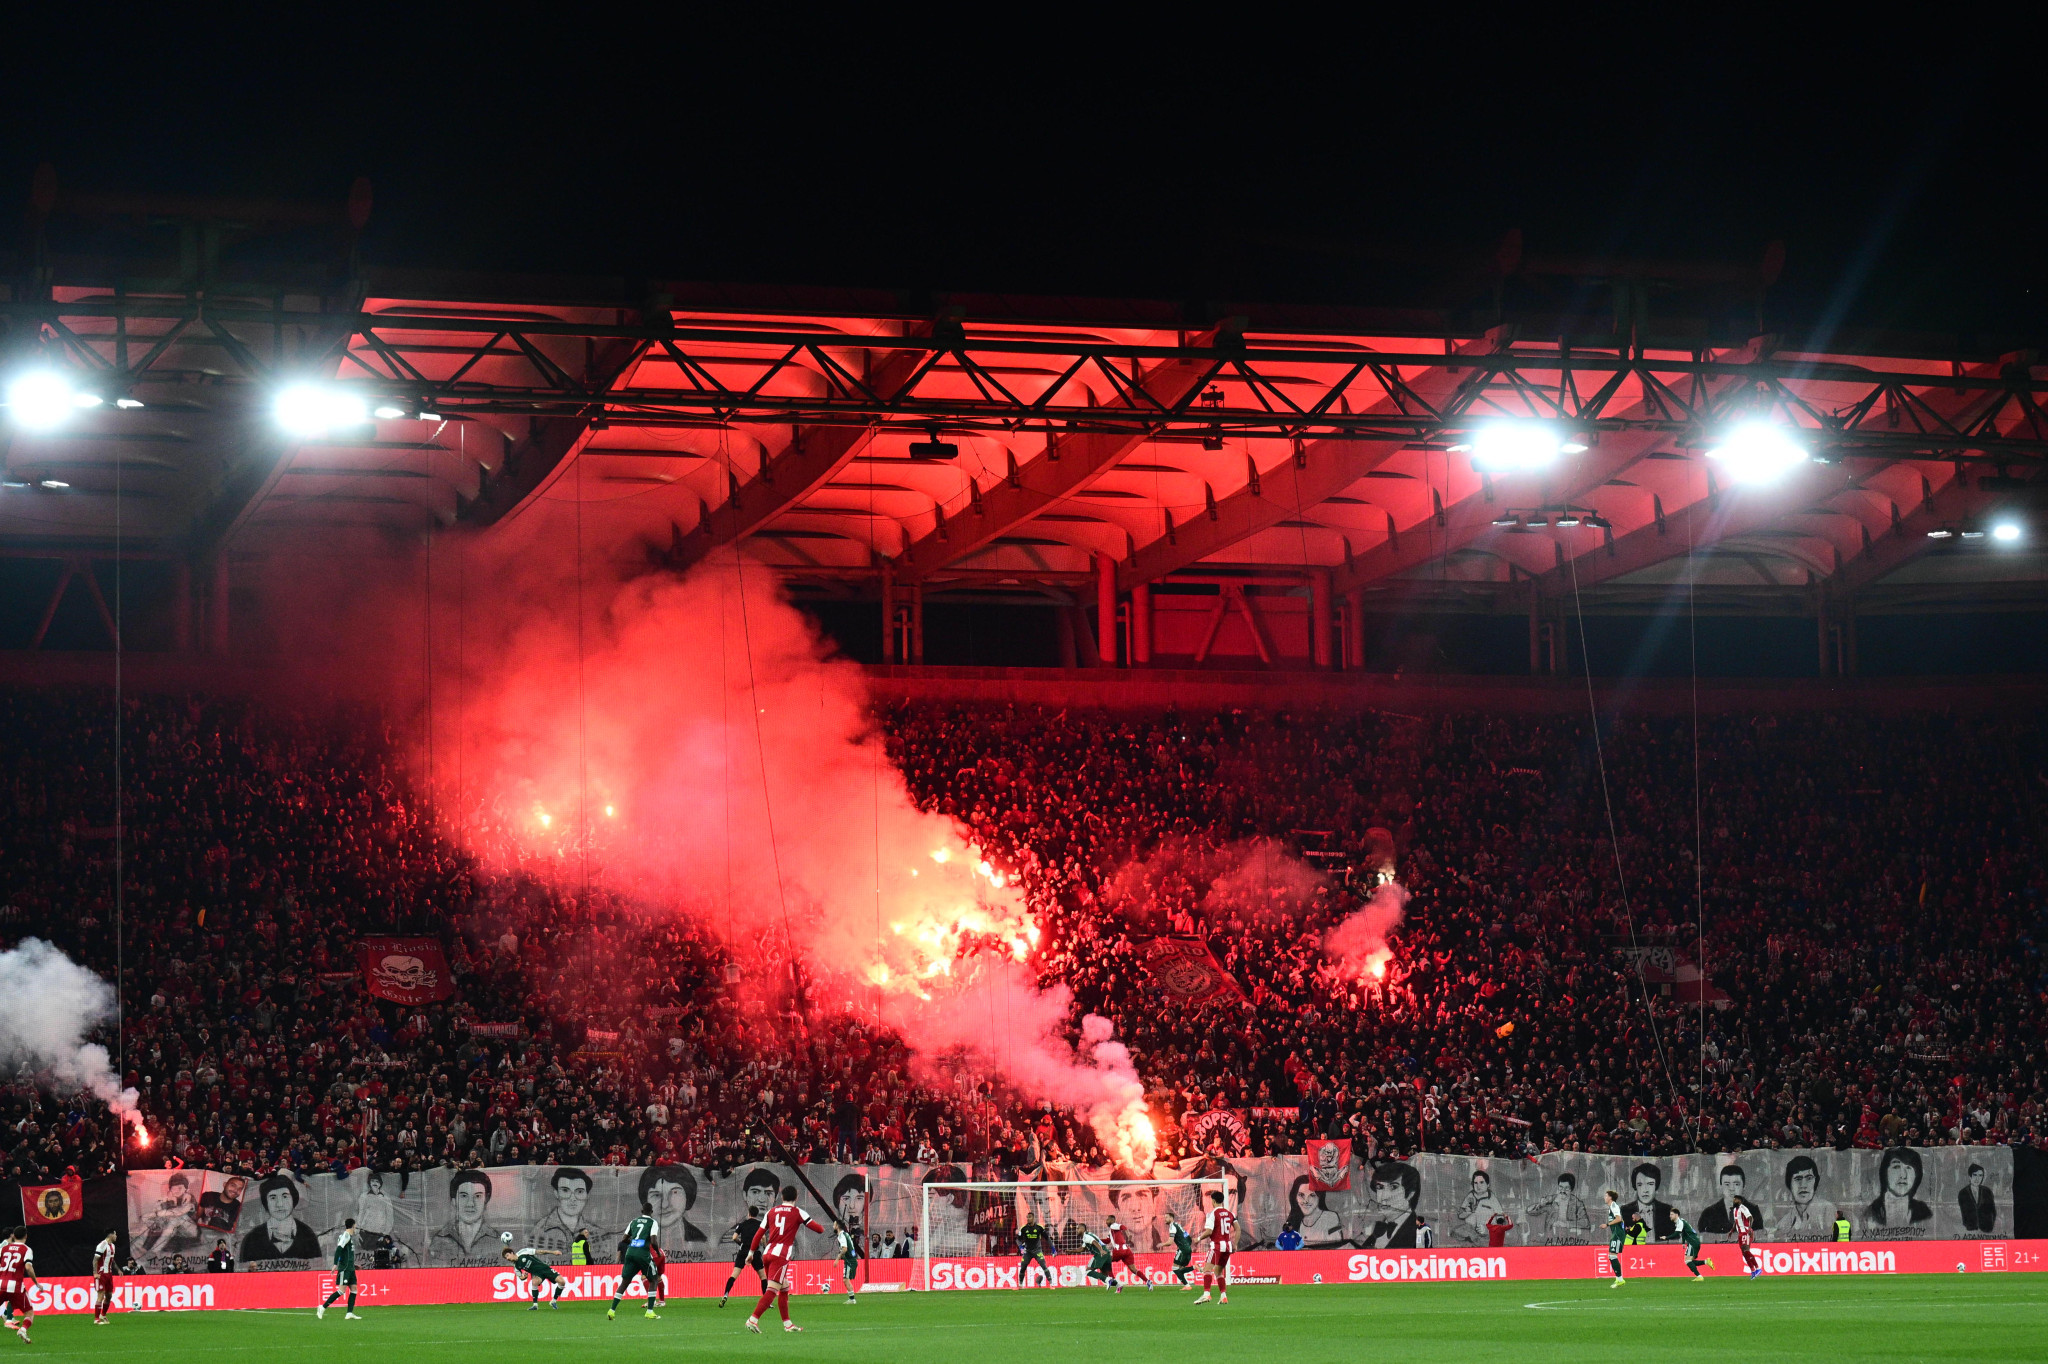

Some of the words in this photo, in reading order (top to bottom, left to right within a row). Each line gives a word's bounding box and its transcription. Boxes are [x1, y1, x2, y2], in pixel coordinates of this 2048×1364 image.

[635, 1223, 644, 1240] 7
[773, 1213, 785, 1235] 4
[1220, 1217, 1231, 1235] 16
[1, 1251, 22, 1273] 32
[1630, 1257, 1656, 1270] 21+
[1743, 1247, 1896, 1274] Stoiximan
[2015, 1251, 2040, 1264] 21+
[1348, 1254, 1507, 1281] Stoiximan
[806, 1273, 837, 1286] 21+
[1231, 1276, 1278, 1284] toiximan
[360, 1283, 391, 1297] 21+
